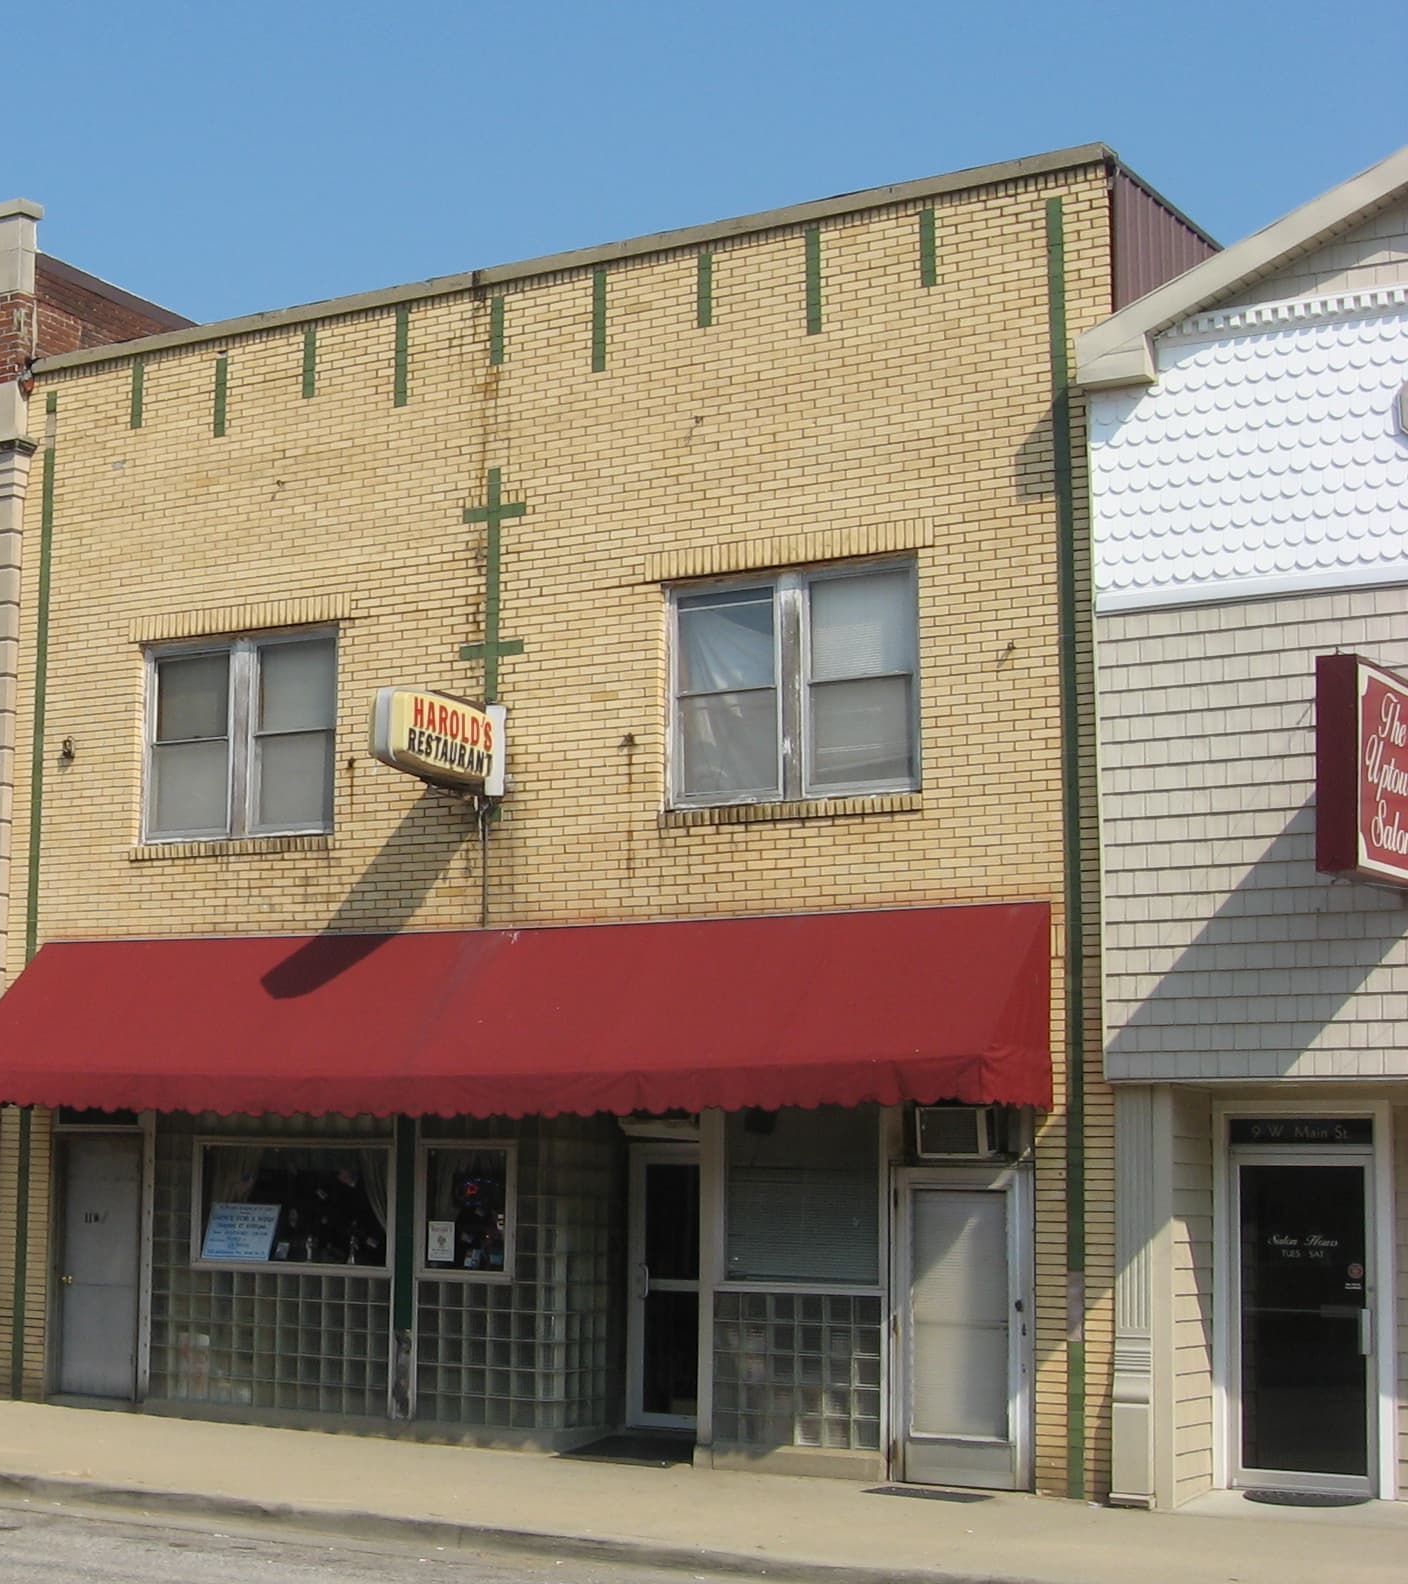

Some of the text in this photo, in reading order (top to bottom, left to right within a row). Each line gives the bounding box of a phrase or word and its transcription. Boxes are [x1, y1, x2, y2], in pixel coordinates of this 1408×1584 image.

[413, 696, 492, 752] HAROLD'S
[1378, 692, 1407, 748] The
[407, 728, 492, 777] RESTAURANT
